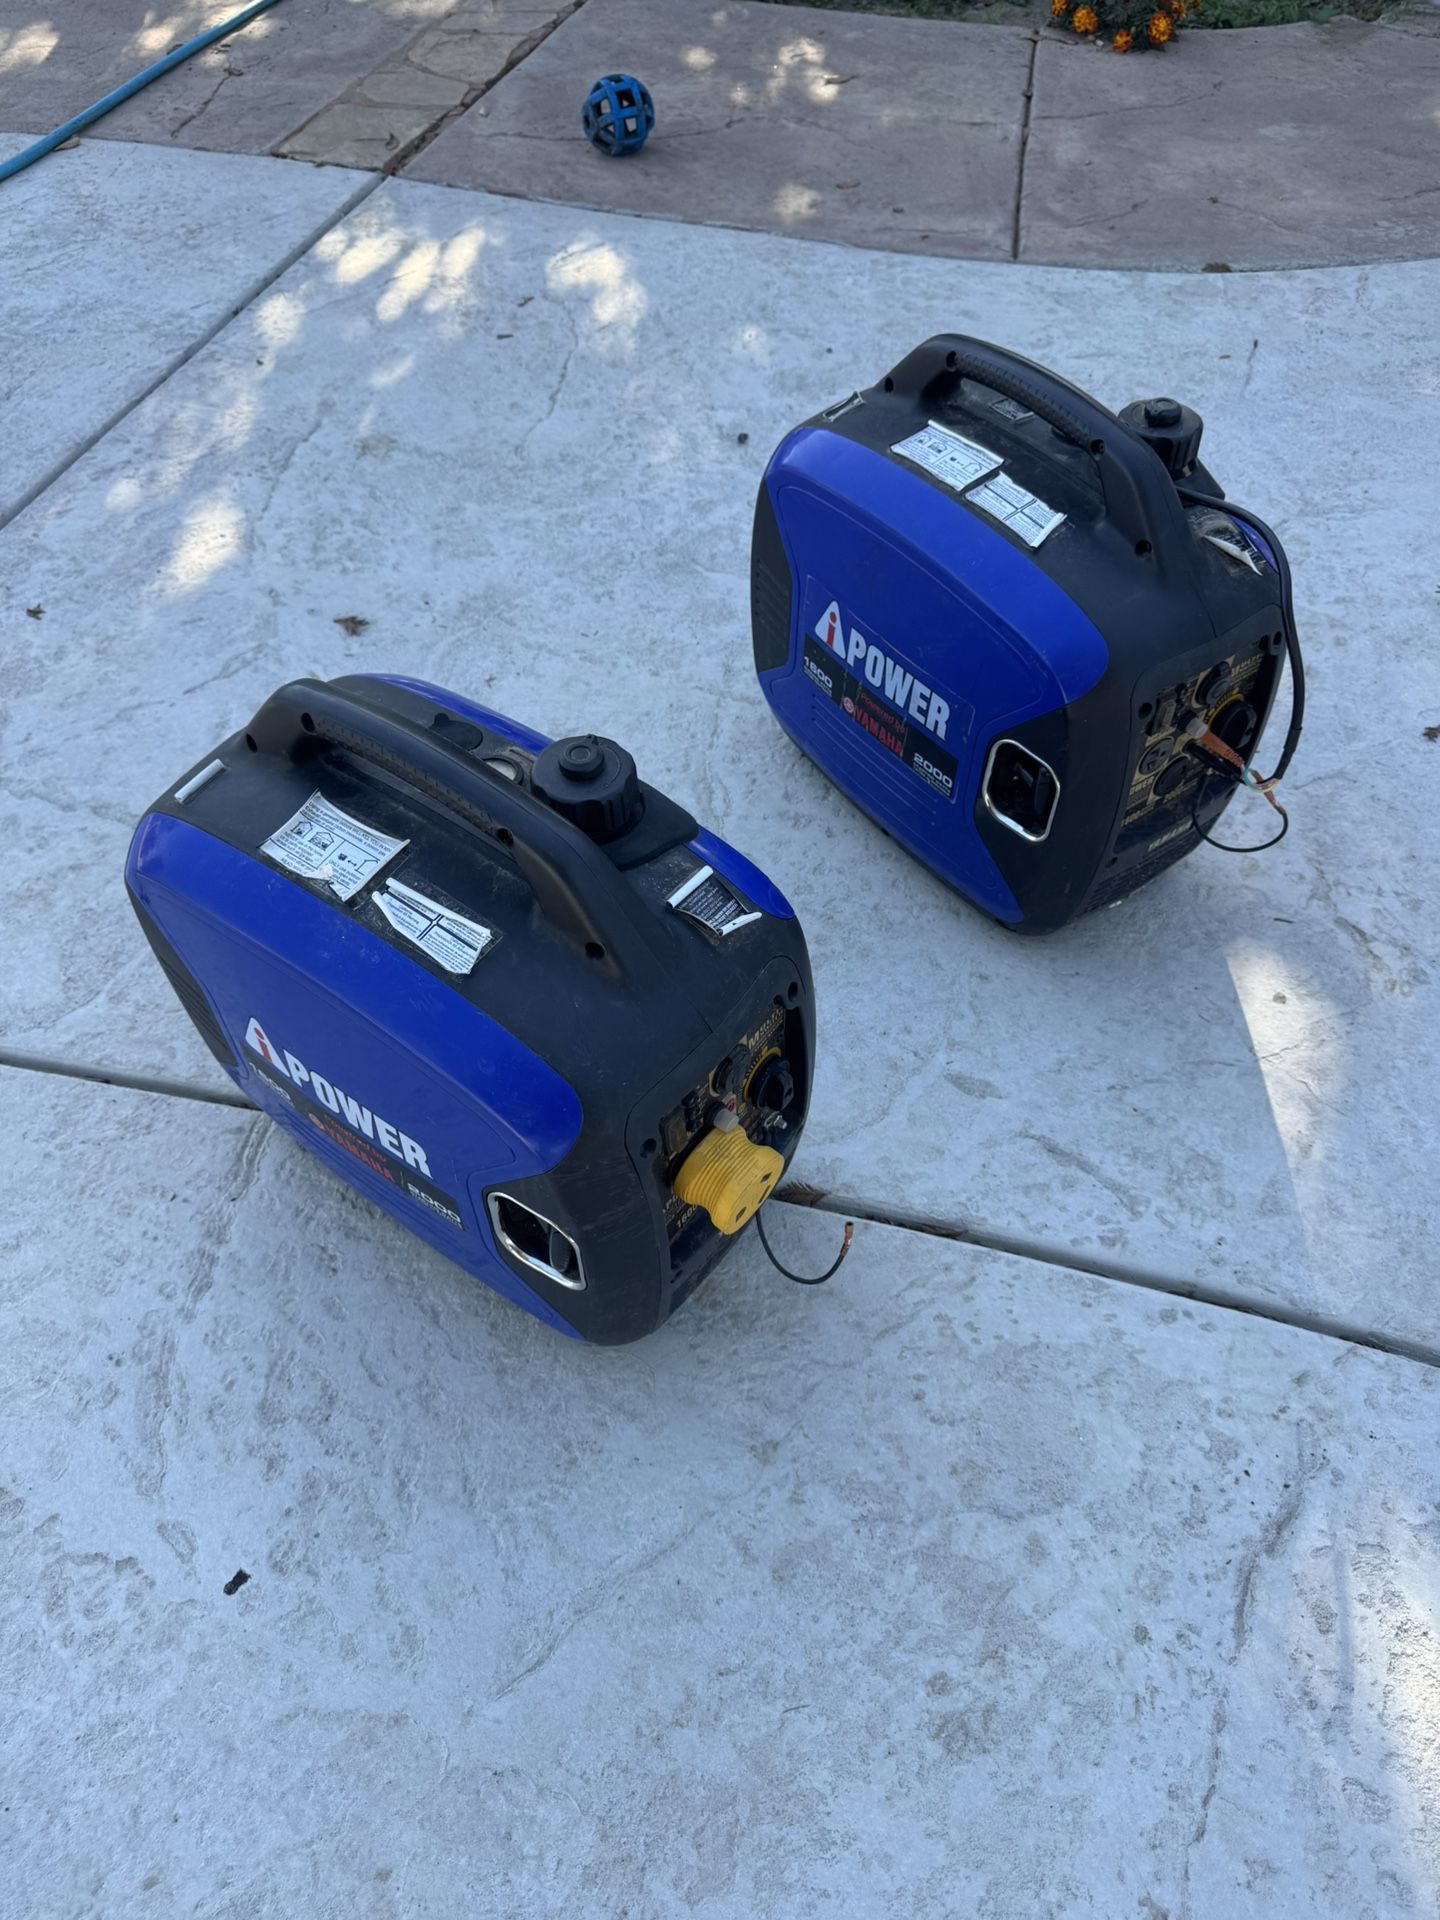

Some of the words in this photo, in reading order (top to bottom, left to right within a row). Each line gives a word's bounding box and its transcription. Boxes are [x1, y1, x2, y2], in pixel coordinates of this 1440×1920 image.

[855, 705, 904, 759] YAMAHA
[913, 752, 953, 789] 2000
[407, 1182, 461, 1224] 2000
